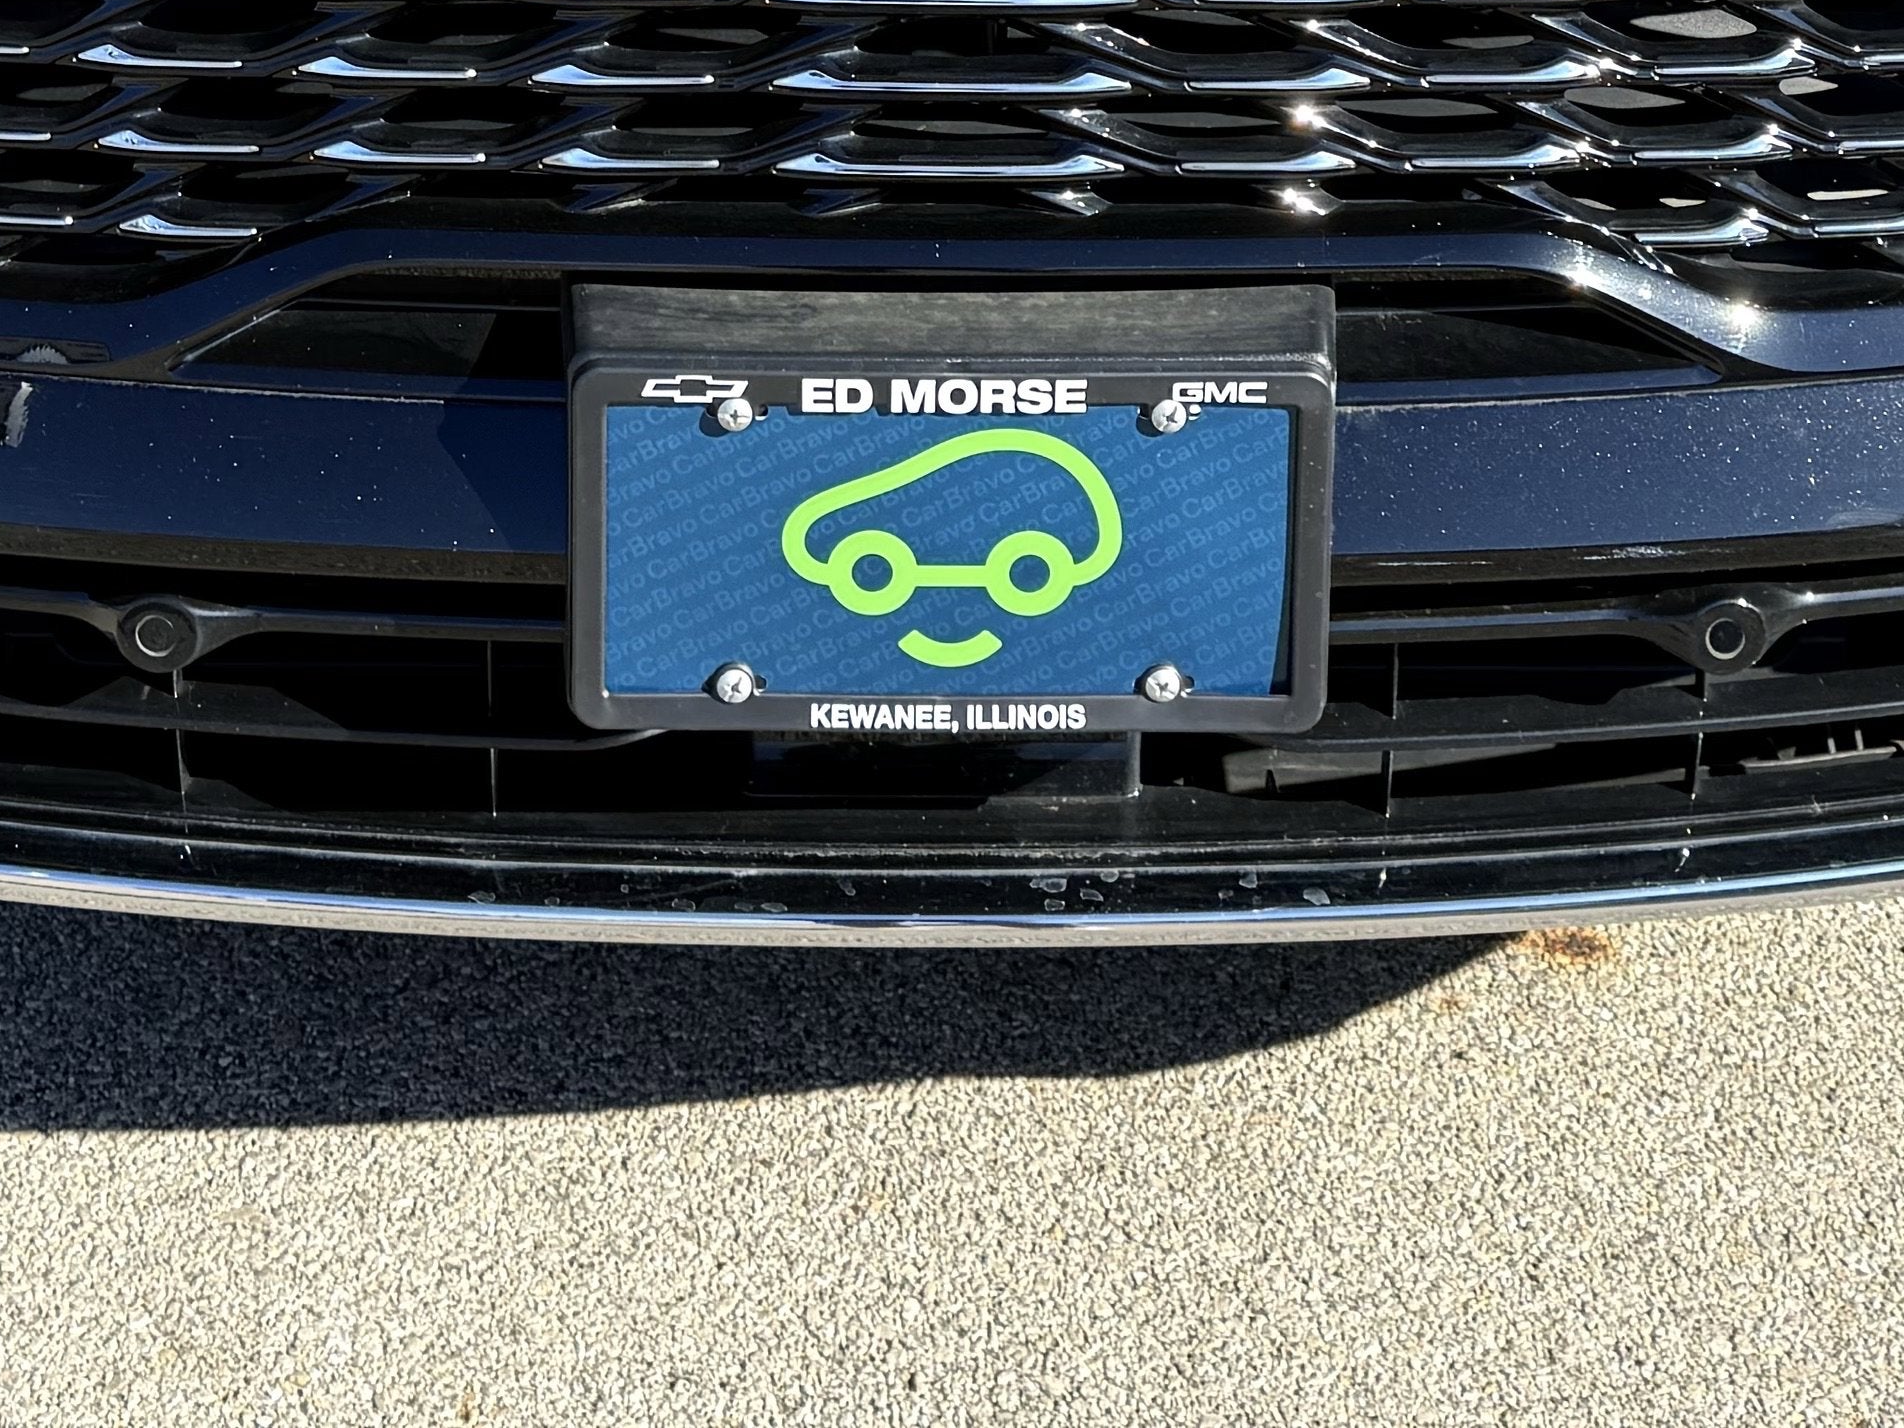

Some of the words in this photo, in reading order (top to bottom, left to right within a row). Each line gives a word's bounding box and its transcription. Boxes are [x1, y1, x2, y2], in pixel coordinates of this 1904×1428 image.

[801, 377, 875, 414] ED
[890, 377, 1088, 415] MORSE
[1171, 380, 1269, 405] GMC
[622, 471, 733, 527] CarBravo
[700, 468, 811, 523] CarBravo
[1094, 563, 1205, 621] CarBravo
[1056, 611, 1168, 668] CarBravo
[810, 702, 961, 734] KEWANEE,
[965, 703, 1088, 731] ILLINOIS
